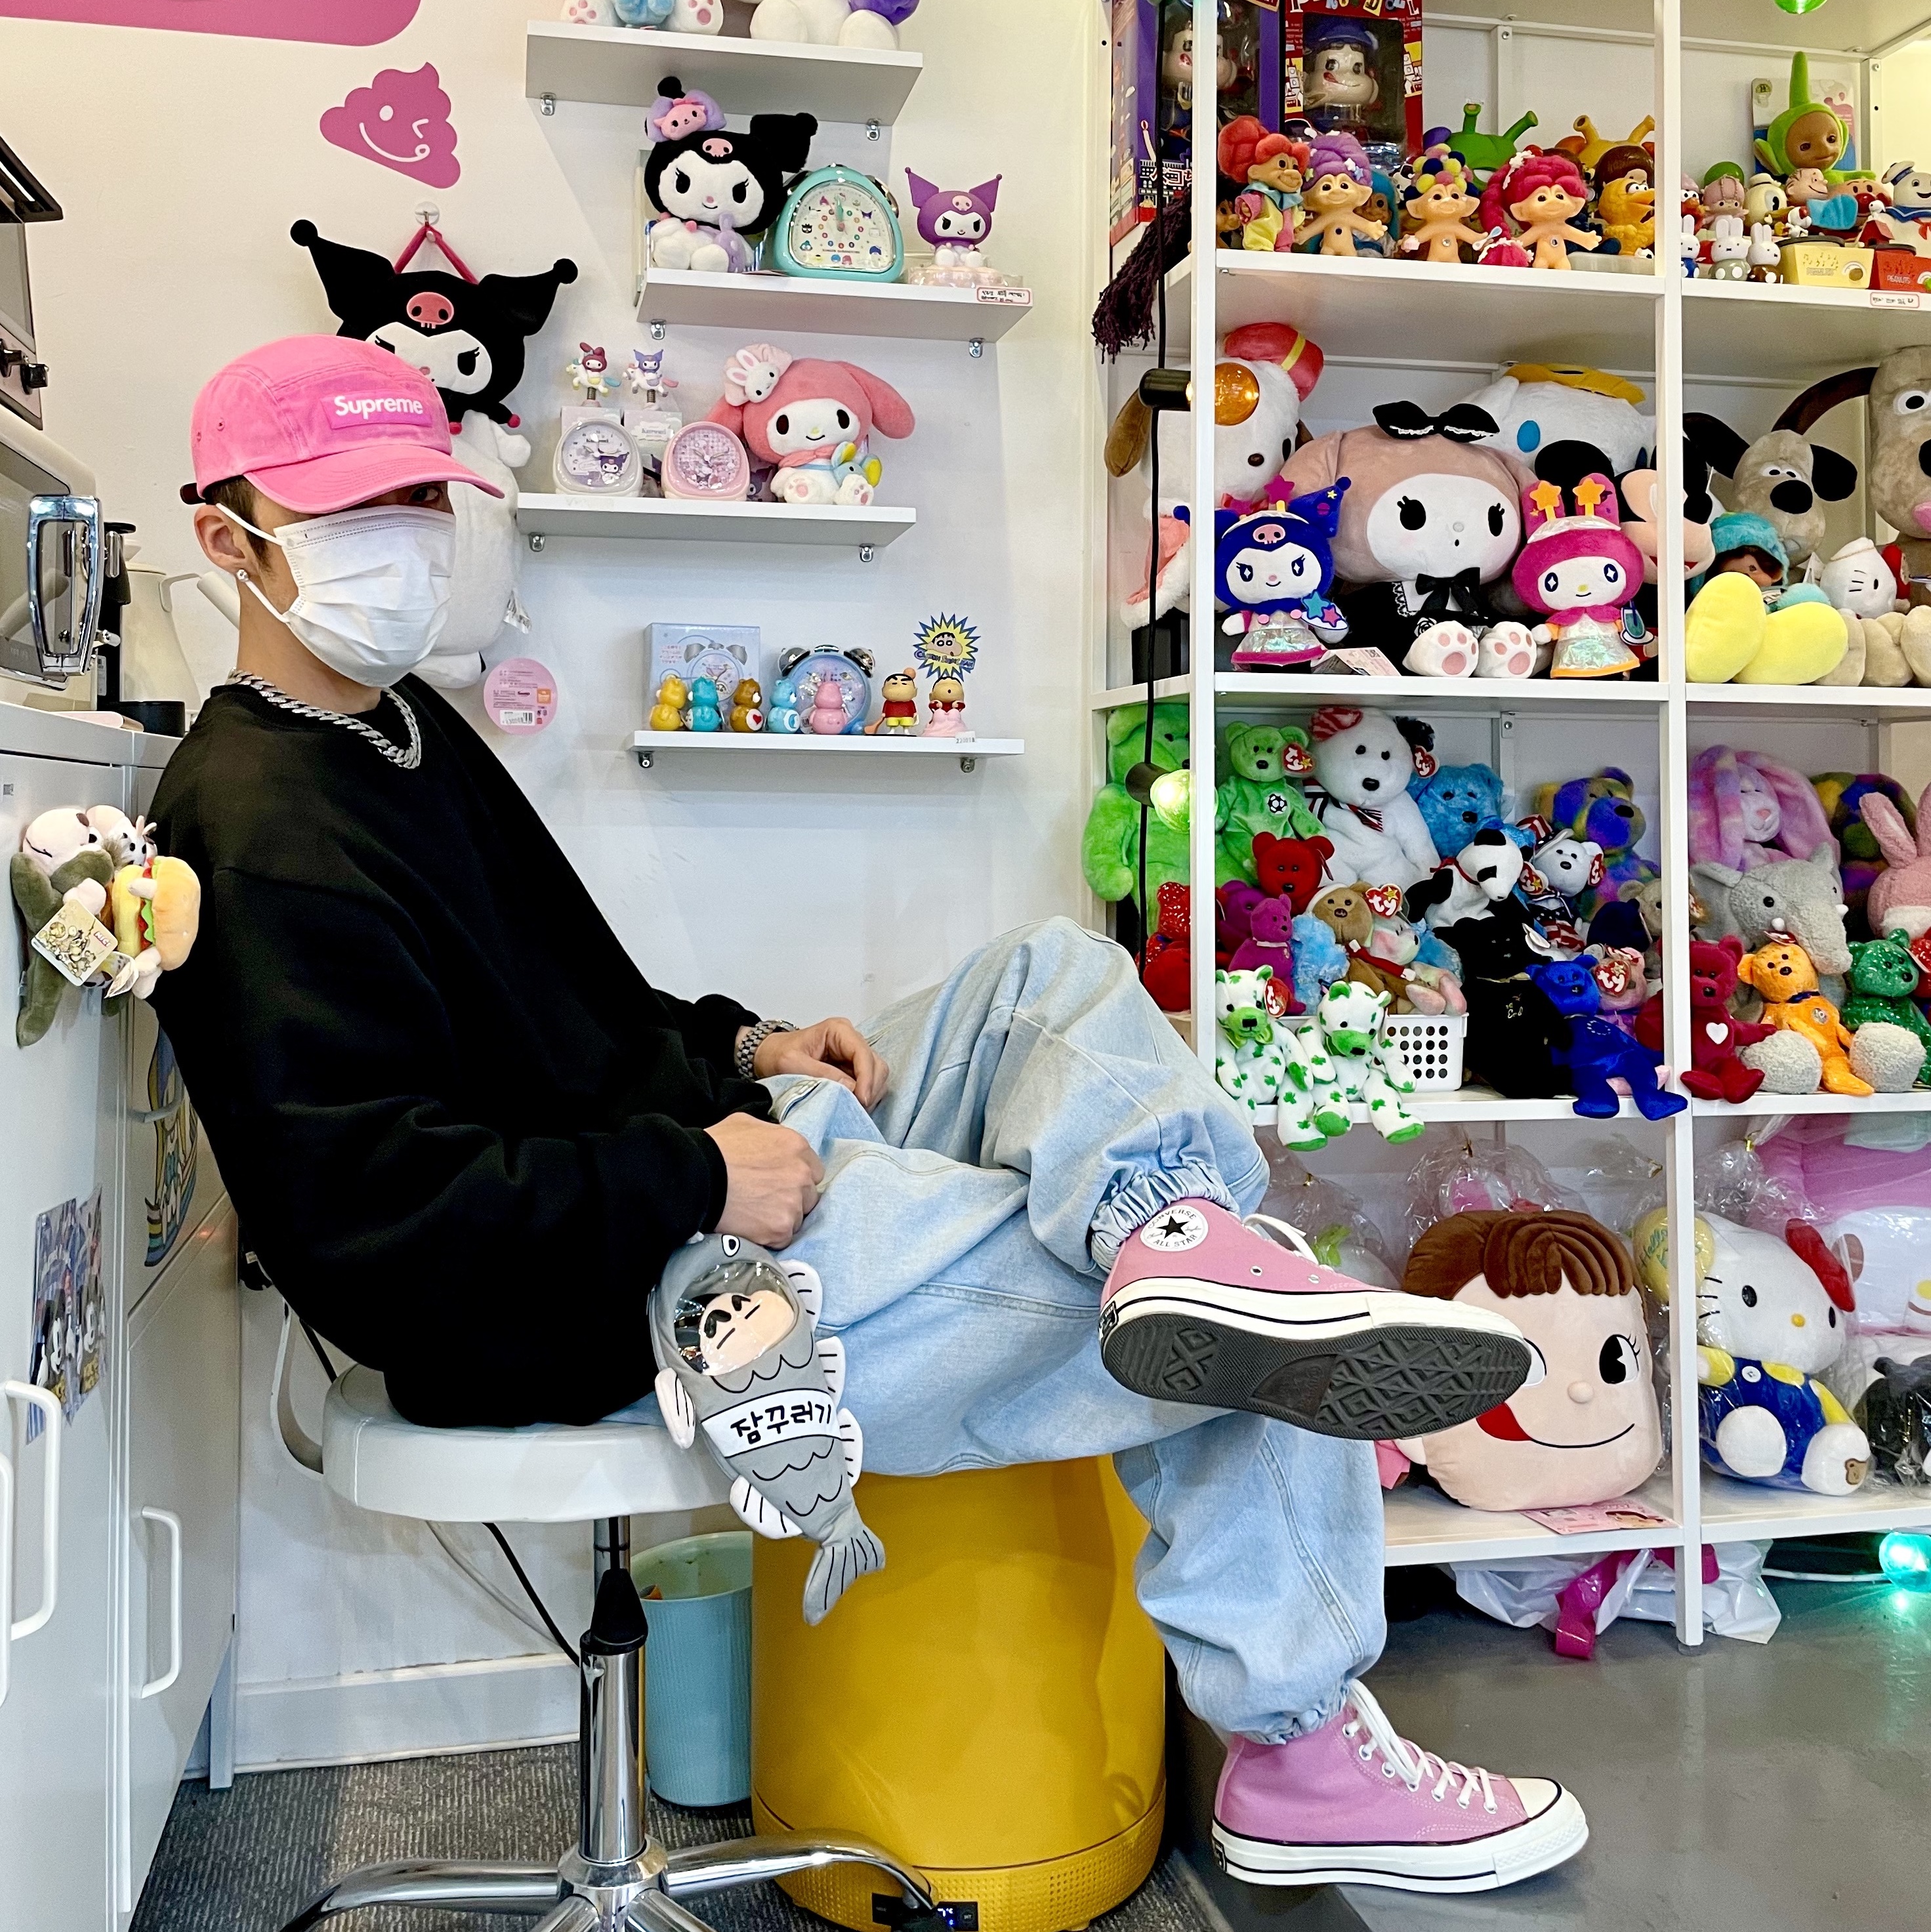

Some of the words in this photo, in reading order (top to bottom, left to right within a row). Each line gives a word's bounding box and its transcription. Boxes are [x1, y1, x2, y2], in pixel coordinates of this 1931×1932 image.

[334, 396, 424, 420] Supreme
[1369, 894, 1397, 915] ty
[1597, 970, 1625, 993] ty
[1148, 1209, 1197, 1229] CONVERSE
[1174, 1234, 1197, 1247] STAR
[730, 1401, 831, 1445] 잠꾸러기
